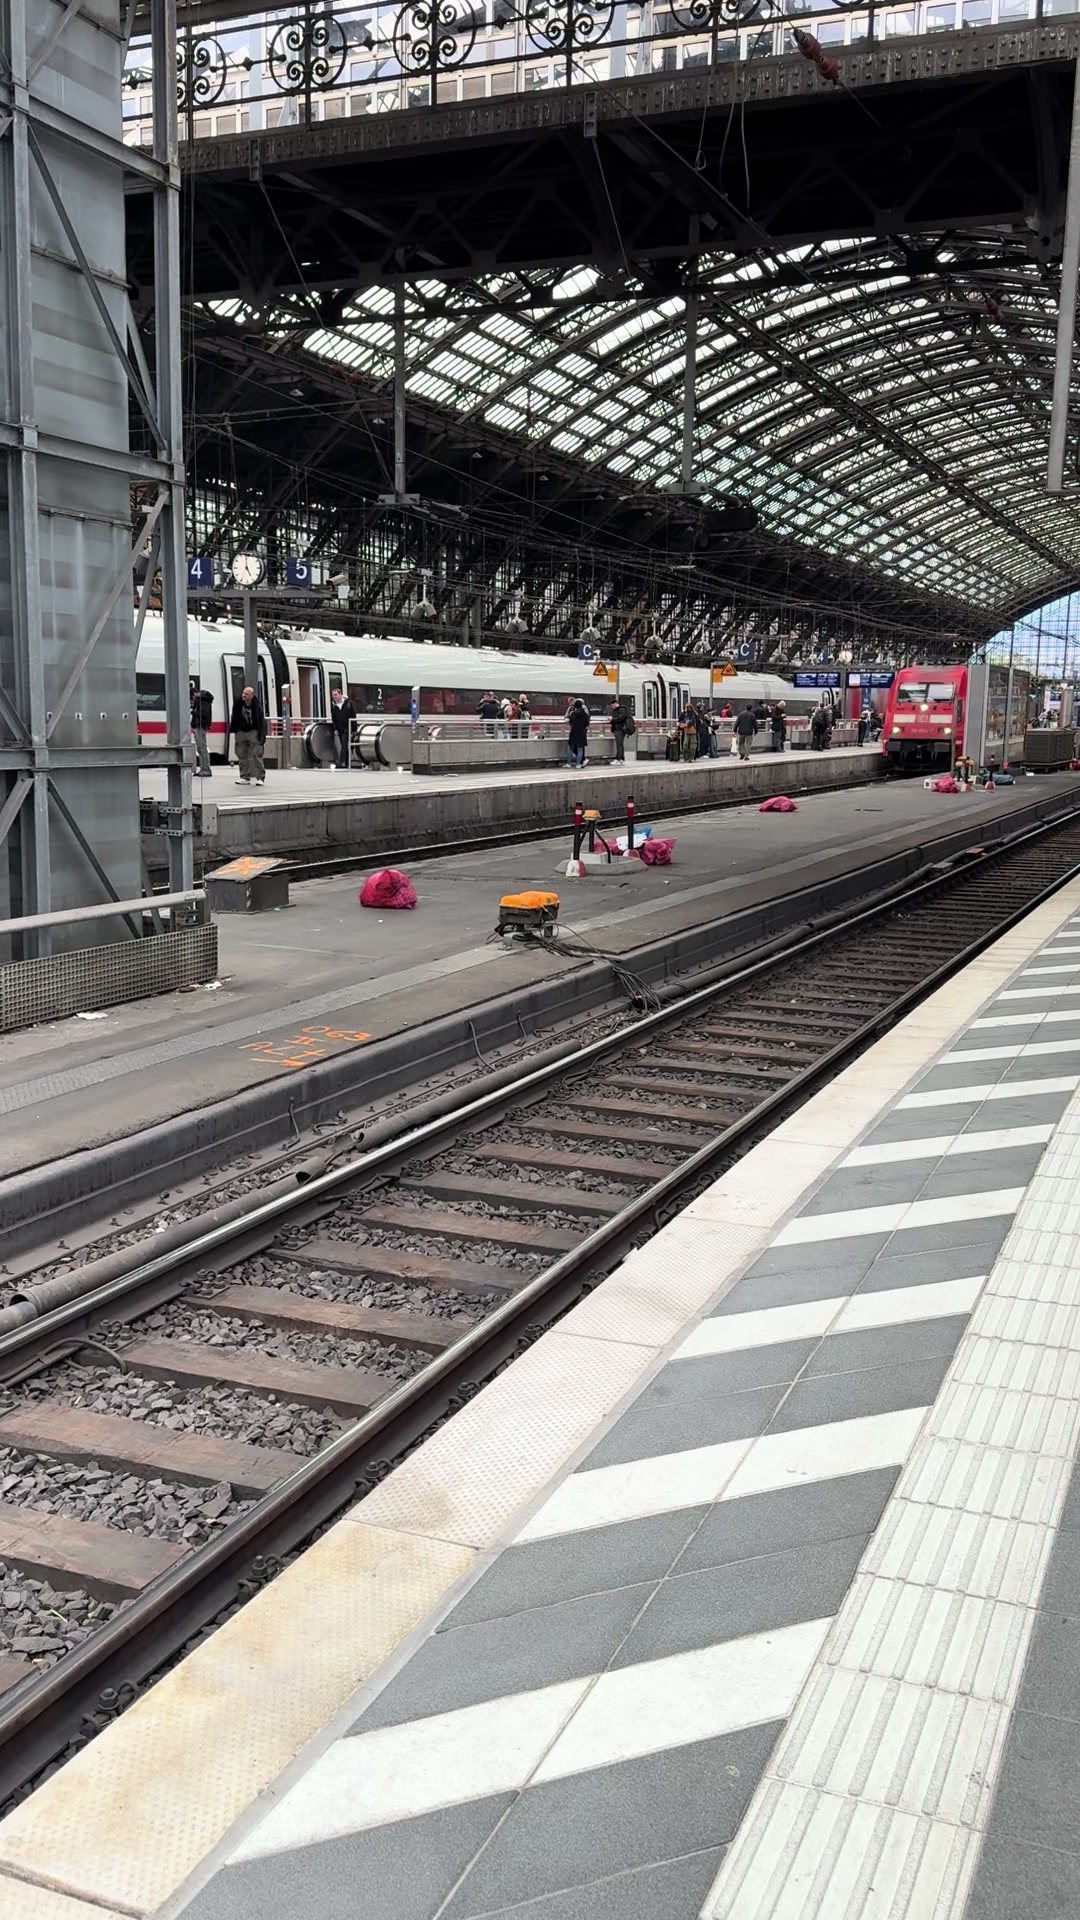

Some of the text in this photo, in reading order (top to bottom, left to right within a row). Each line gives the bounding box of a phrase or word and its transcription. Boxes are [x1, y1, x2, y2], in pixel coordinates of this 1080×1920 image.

[190, 558, 203, 579] 4
[295, 558, 308, 579] 5
[583, 644, 592, 657] C
[740, 643, 750, 657] C
[377, 688, 383, 699] 2
